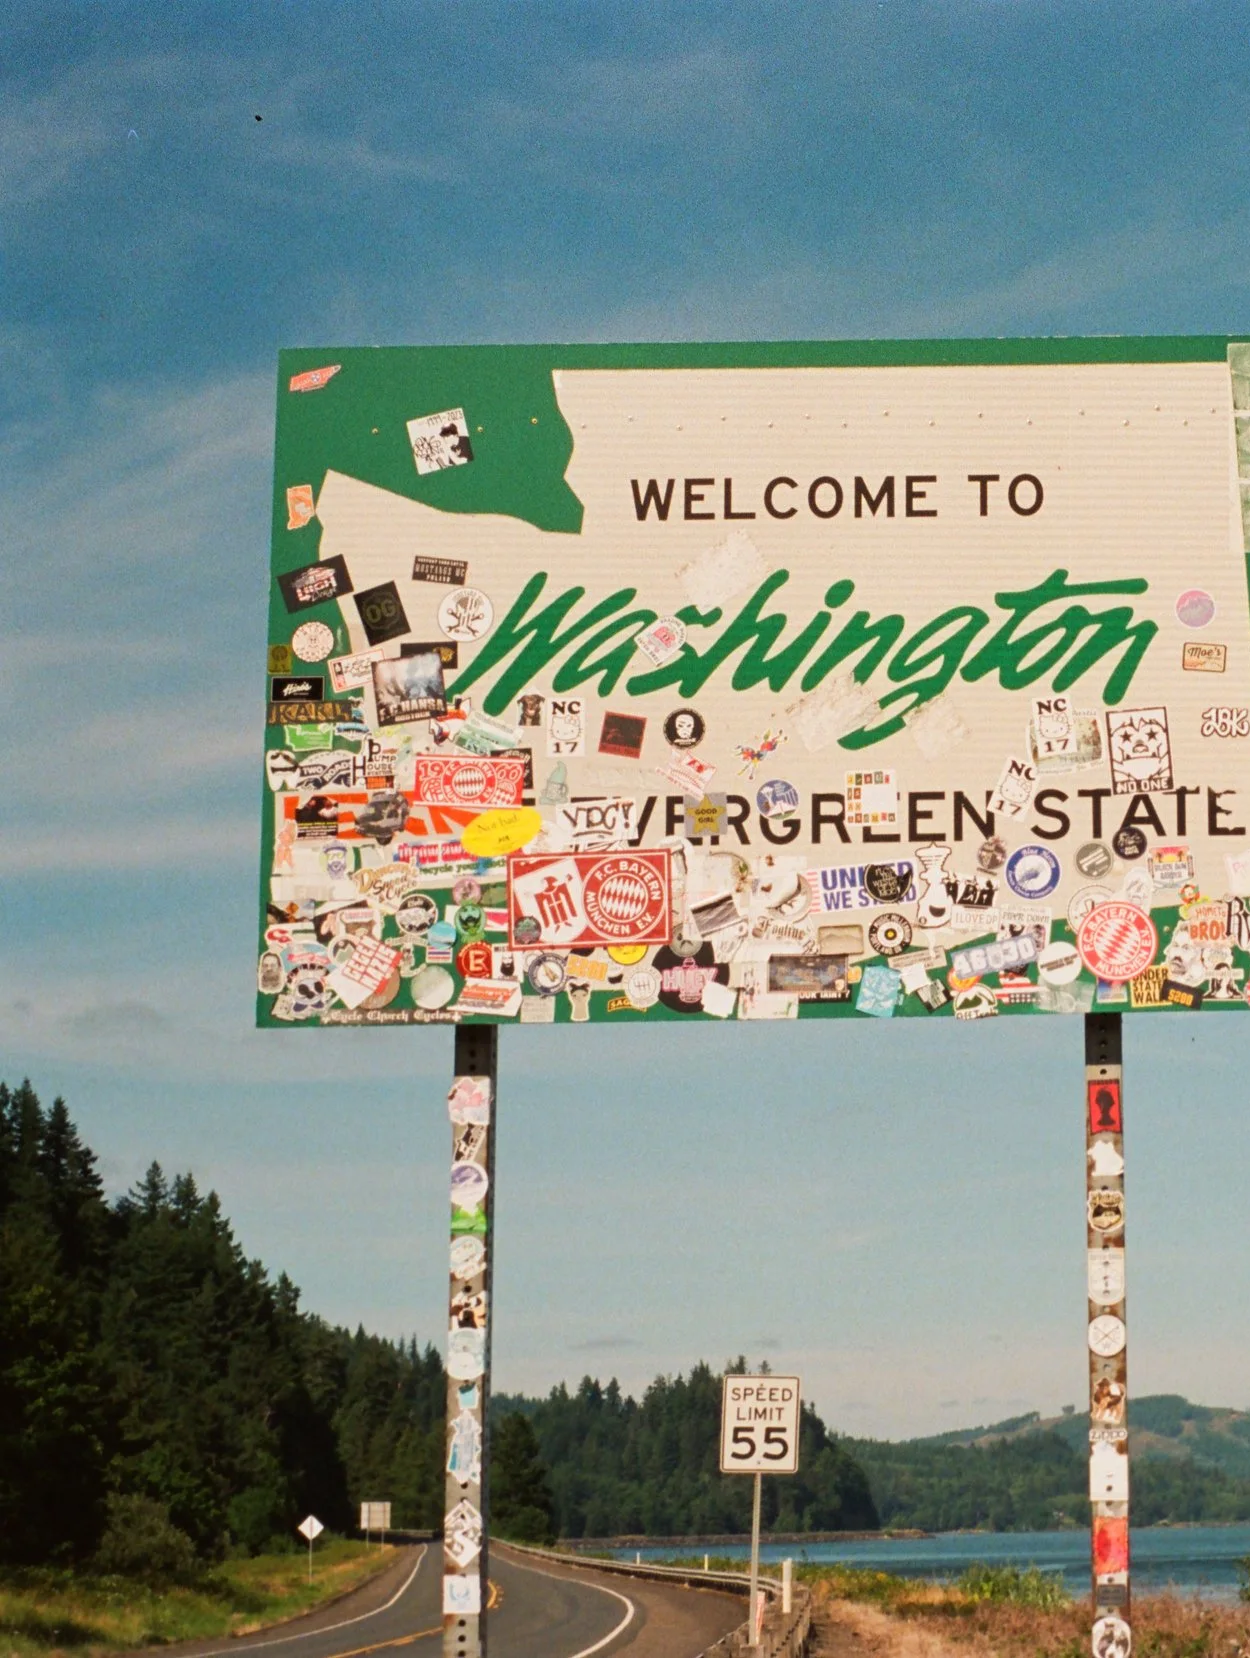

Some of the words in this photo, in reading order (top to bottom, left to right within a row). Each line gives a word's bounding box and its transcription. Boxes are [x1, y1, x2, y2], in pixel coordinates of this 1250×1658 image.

[630, 474, 938, 521] WELCOME
[968, 473, 1044, 517] TO
[365, 599, 397, 624] OG
[447, 568, 1159, 750] Washington
[1187, 646, 1222, 659] Moe's
[401, 698, 446, 714] HANSA
[551, 701, 582, 715] NC
[1036, 698, 1067, 715] NC
[553, 742, 579, 754] 17
[1044, 738, 1069, 753] 17
[303, 766, 323, 775] TWO
[1008, 759, 1037, 781] NC
[1140, 777, 1170, 791] ONE
[995, 799, 1022, 816] 17
[571, 790, 995, 847] VERGREN
[1030, 786, 1247, 840] STATE
[618, 860, 662, 901] BAYERN
[824, 890, 853, 911] WE
[1088, 906, 1138, 930] BAYERN
[330, 1011, 363, 1022] Cycle
[366, 1011, 409, 1023] Church
[413, 1011, 451, 1022] Cycles
[731, 1387, 793, 1402] SPEED
[736, 1407, 785, 1421] LIMIT
[730, 1426, 789, 1461] 55
